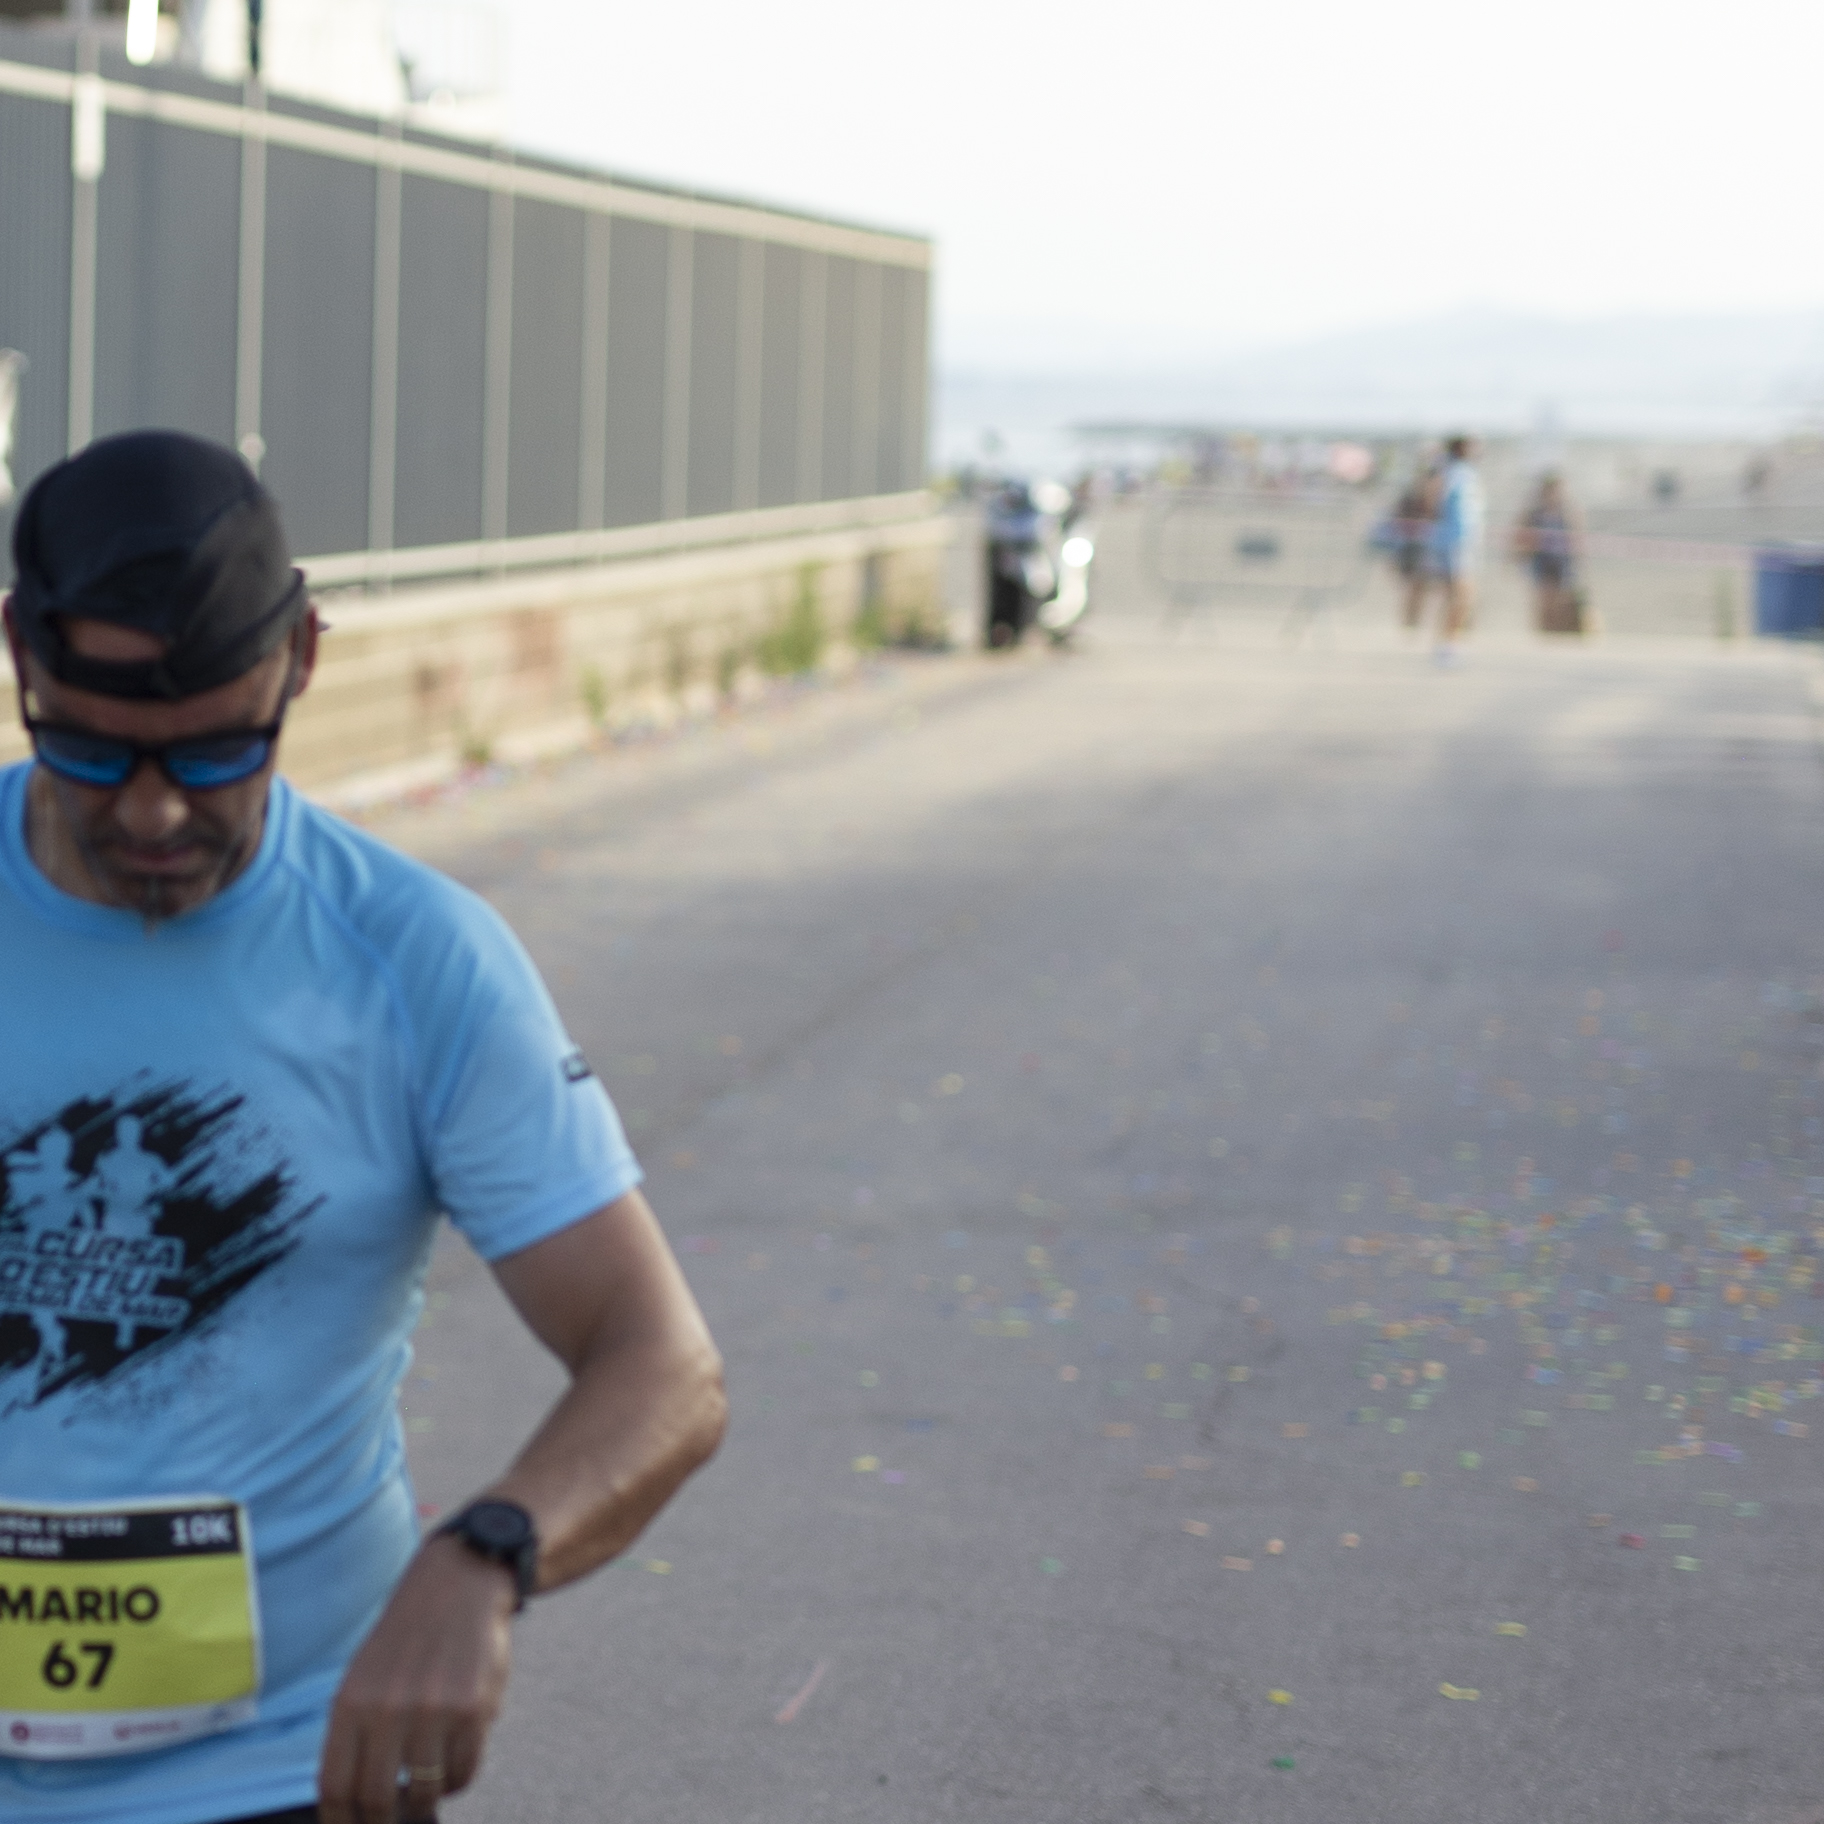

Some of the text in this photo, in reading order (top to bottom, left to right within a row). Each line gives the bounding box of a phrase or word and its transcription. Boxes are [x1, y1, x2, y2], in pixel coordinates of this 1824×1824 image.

[36, 1231, 176, 1268] CURSA
[171, 1514, 233, 1547] 10K
[42, 1641, 115, 1691] 67
